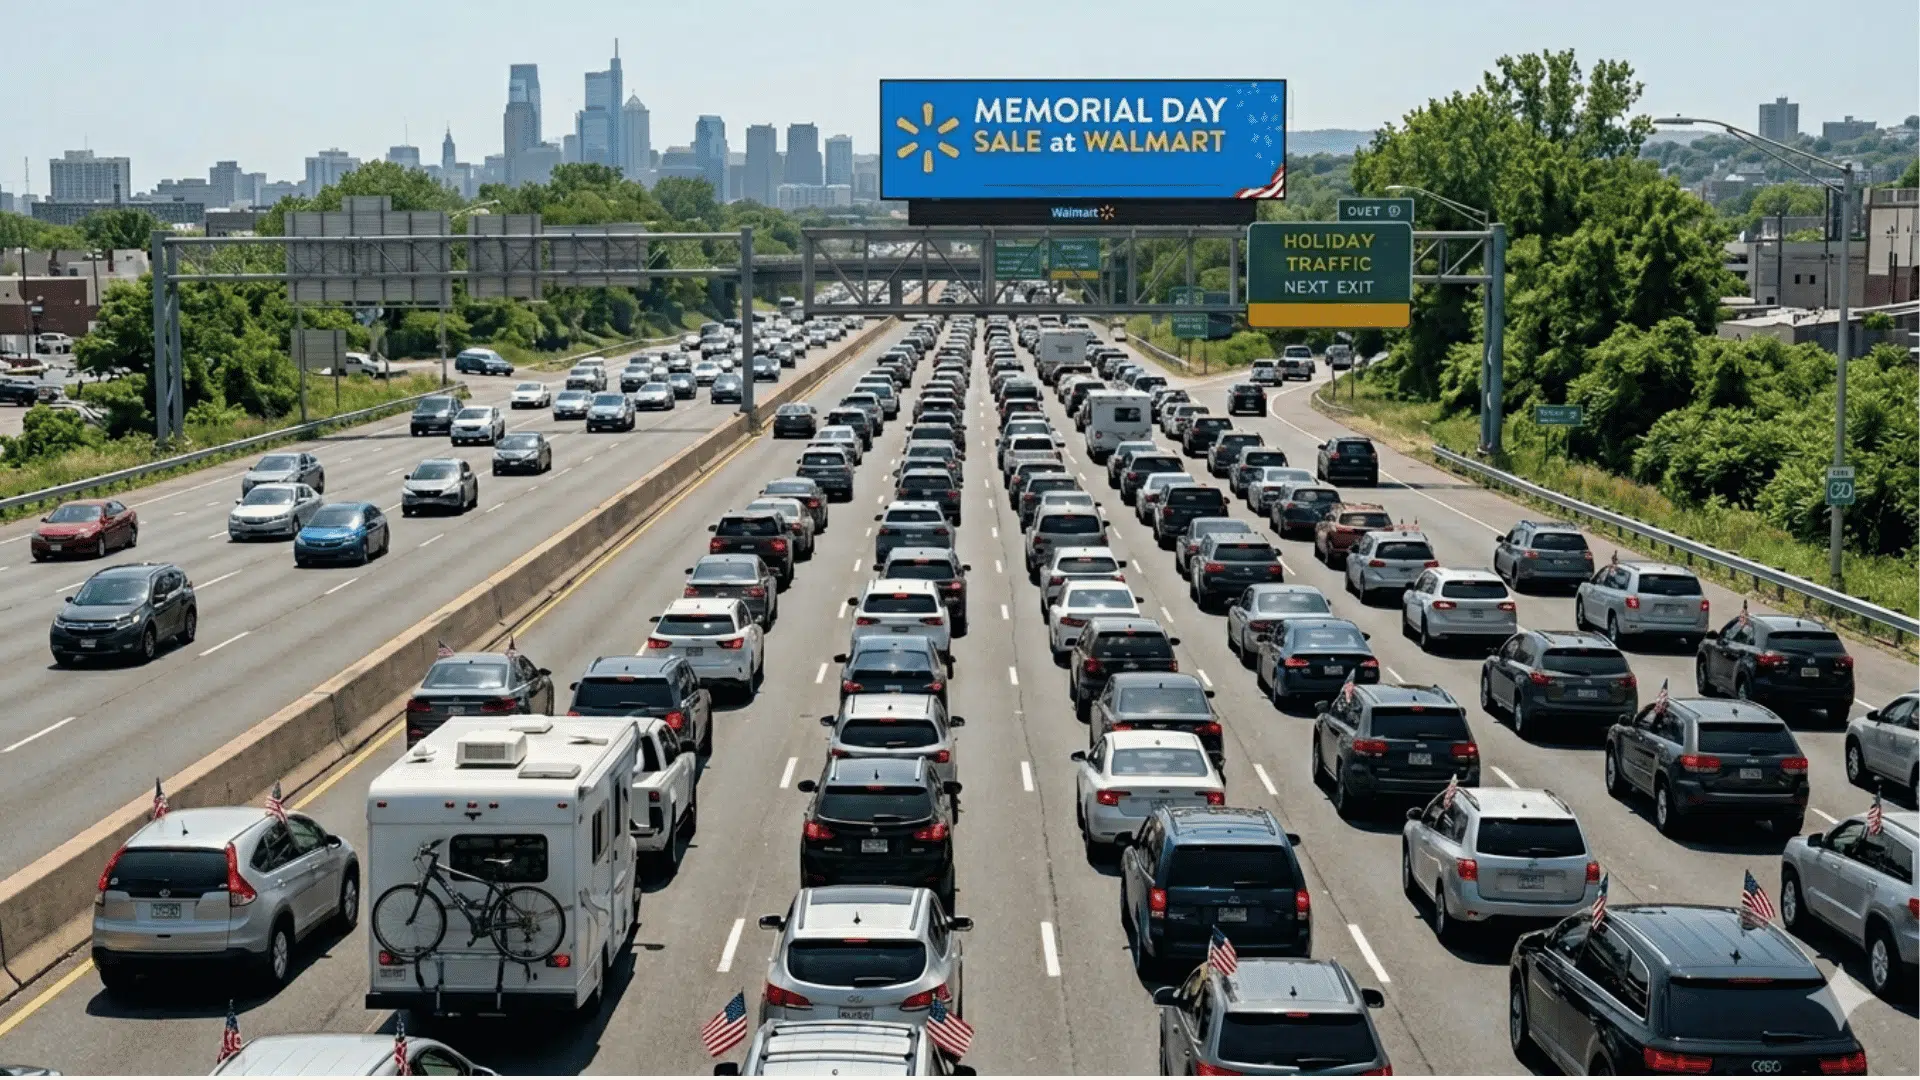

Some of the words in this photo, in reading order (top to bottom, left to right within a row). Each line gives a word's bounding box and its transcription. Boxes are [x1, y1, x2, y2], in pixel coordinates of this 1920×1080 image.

[974, 97, 1153, 123] MEMORIAL
[1163, 97, 1228, 123] DAY
[974, 130, 1042, 153] SALE
[1050, 133, 1076, 153] at
[1084, 130, 1226, 153] WALMART
[1051, 207, 1099, 218] Walmart
[1284, 234, 1375, 249] HOLIDAY
[1286, 257, 1372, 272] TRAFFIC
[1284, 281, 1329, 294] NEXT
[1337, 281, 1374, 294] EXIT
